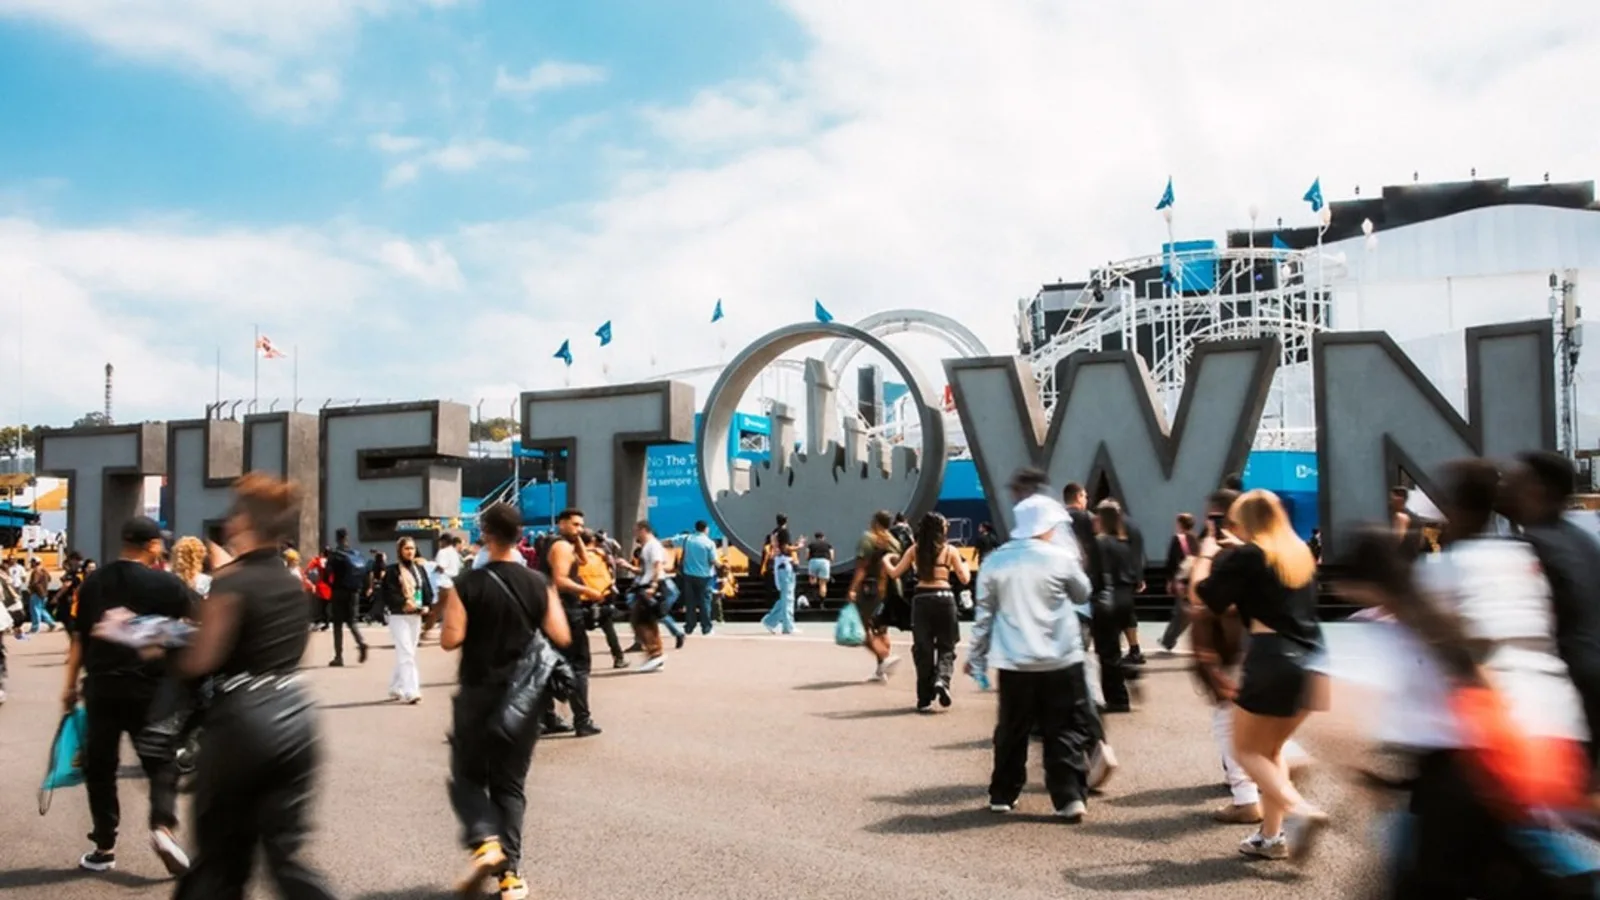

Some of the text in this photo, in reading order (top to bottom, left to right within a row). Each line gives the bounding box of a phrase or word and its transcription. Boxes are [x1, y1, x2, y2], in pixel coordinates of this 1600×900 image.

[36, 319, 1557, 573] THE TOWN
[648, 456, 664, 467] No
[665, 454, 686, 466] The
[658, 477, 691, 488] sempre
